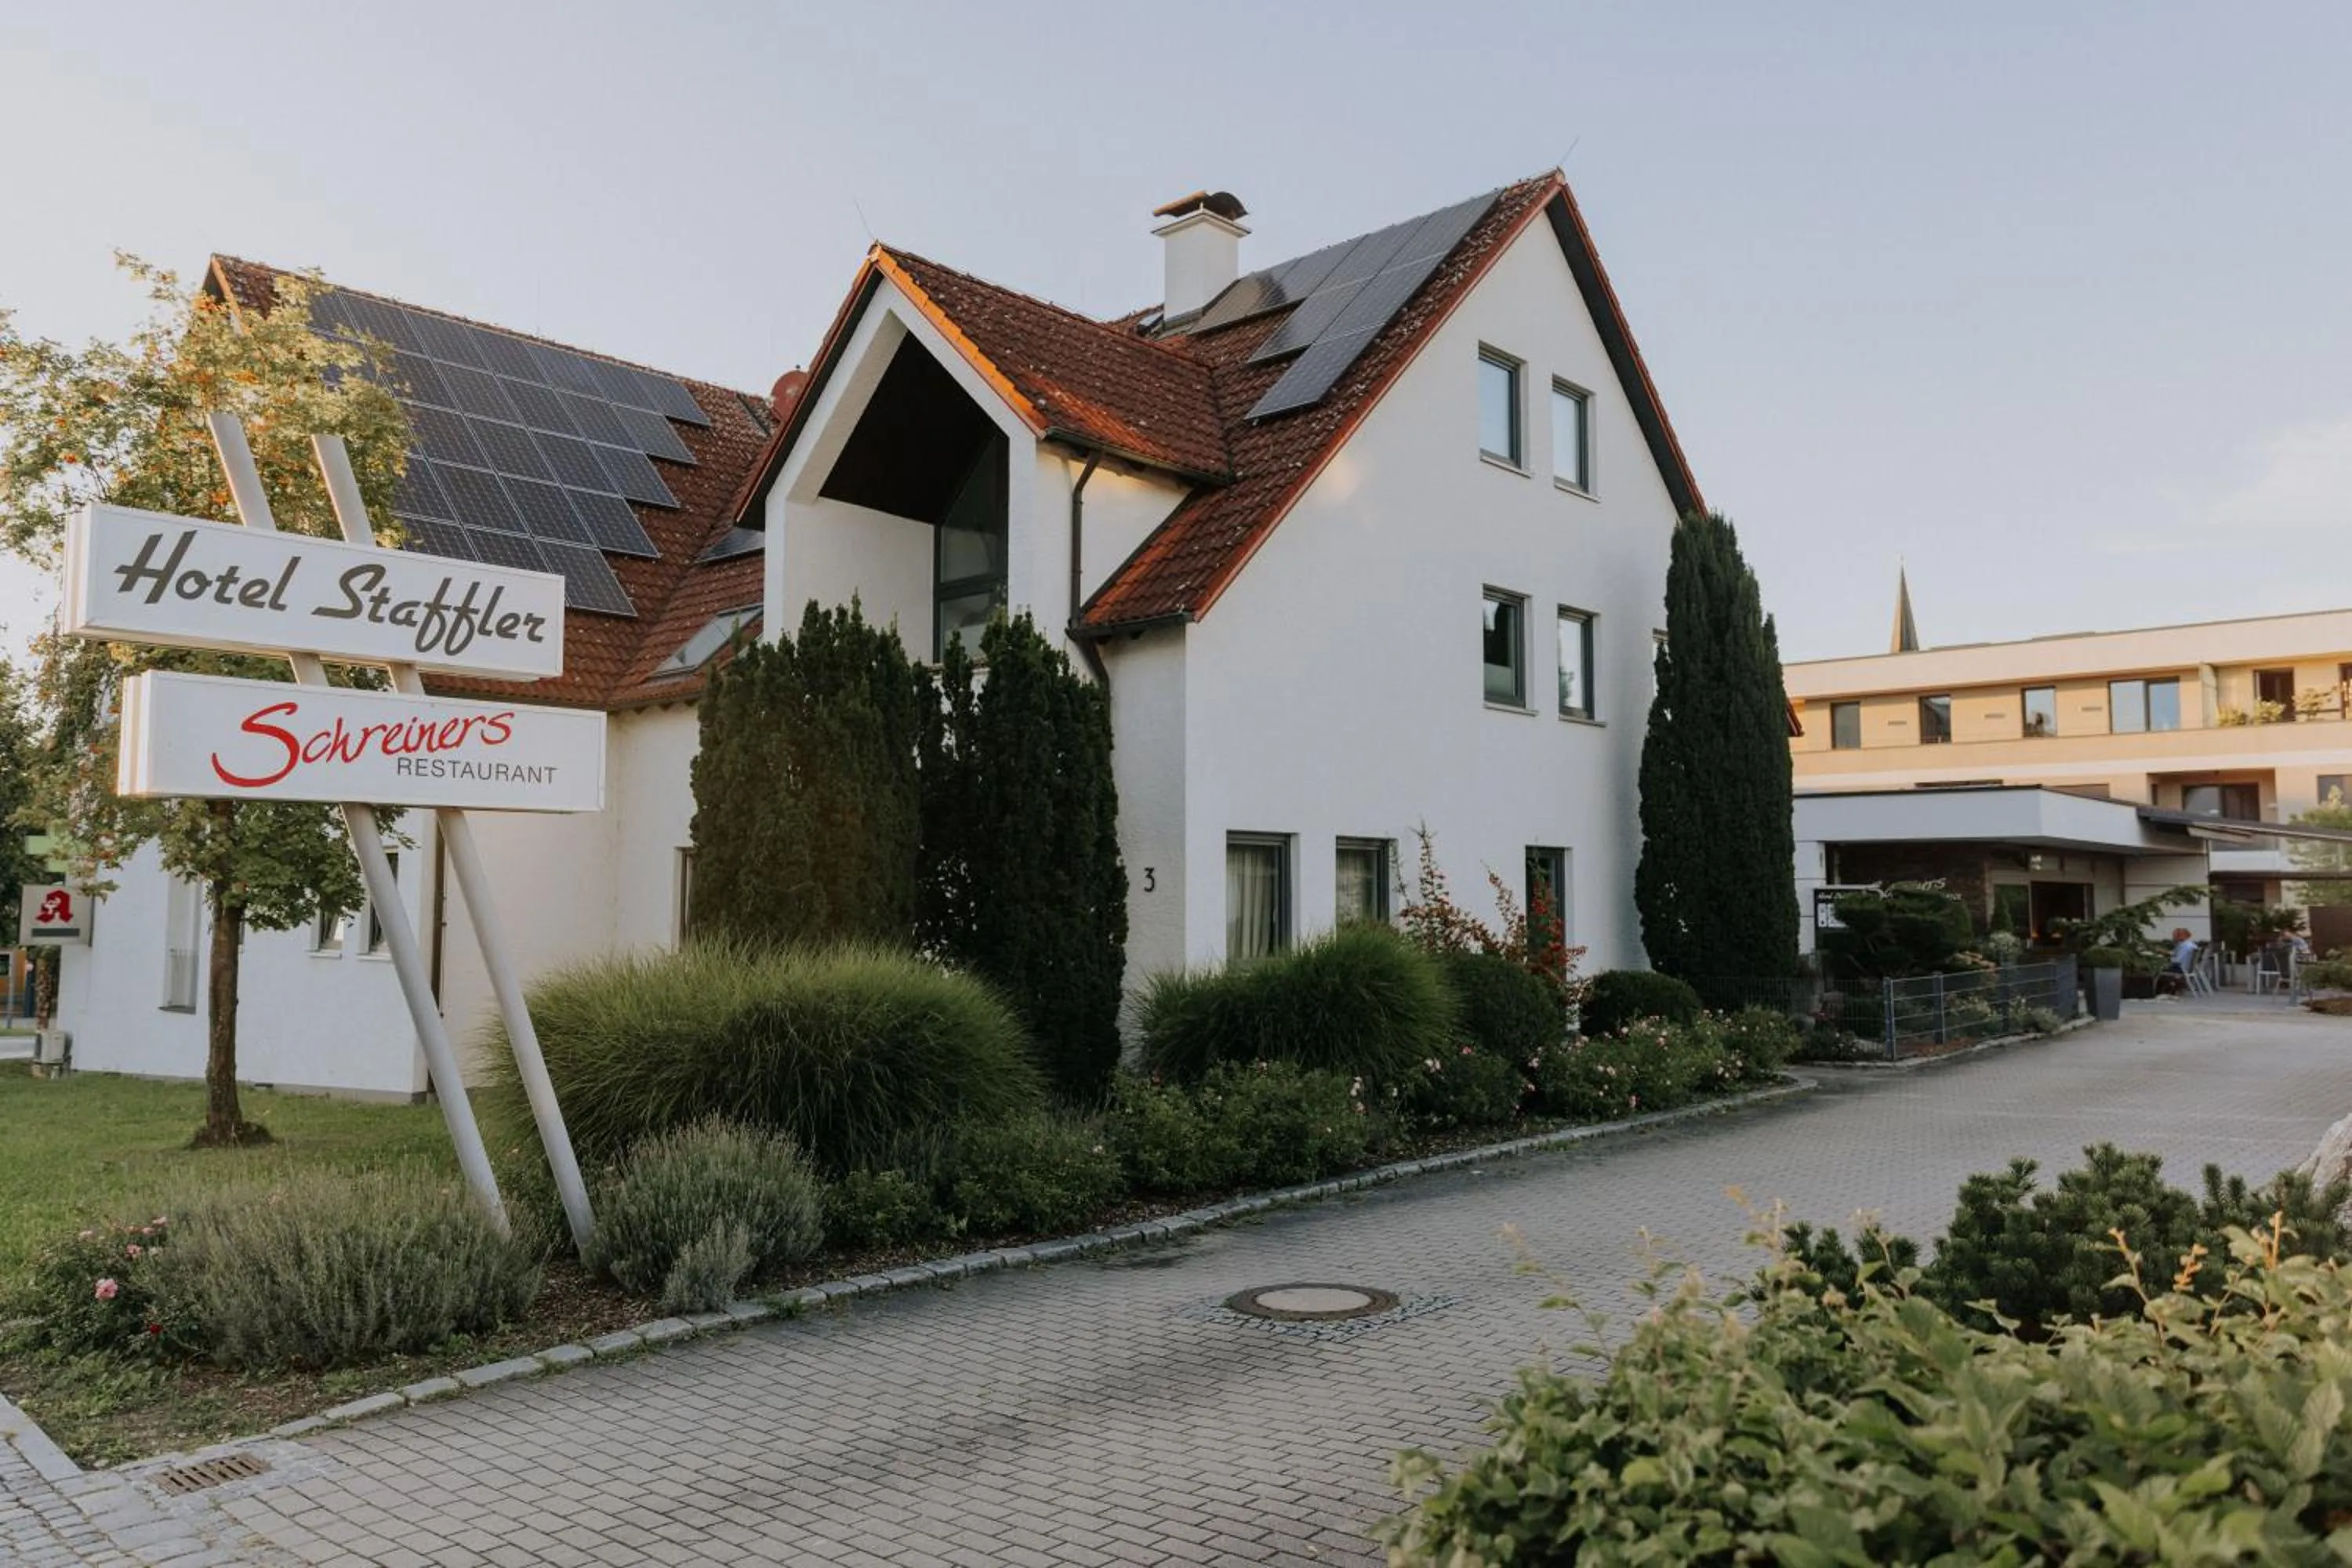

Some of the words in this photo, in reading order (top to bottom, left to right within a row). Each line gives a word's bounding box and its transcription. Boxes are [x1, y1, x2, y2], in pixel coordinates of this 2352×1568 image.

[114, 530, 301, 612] Hotel
[312, 564, 546, 656] Staffler
[212, 702, 514, 787] Schreiners
[397, 757, 557, 784] RESTAURANT
[1144, 867, 1155, 892] 3
